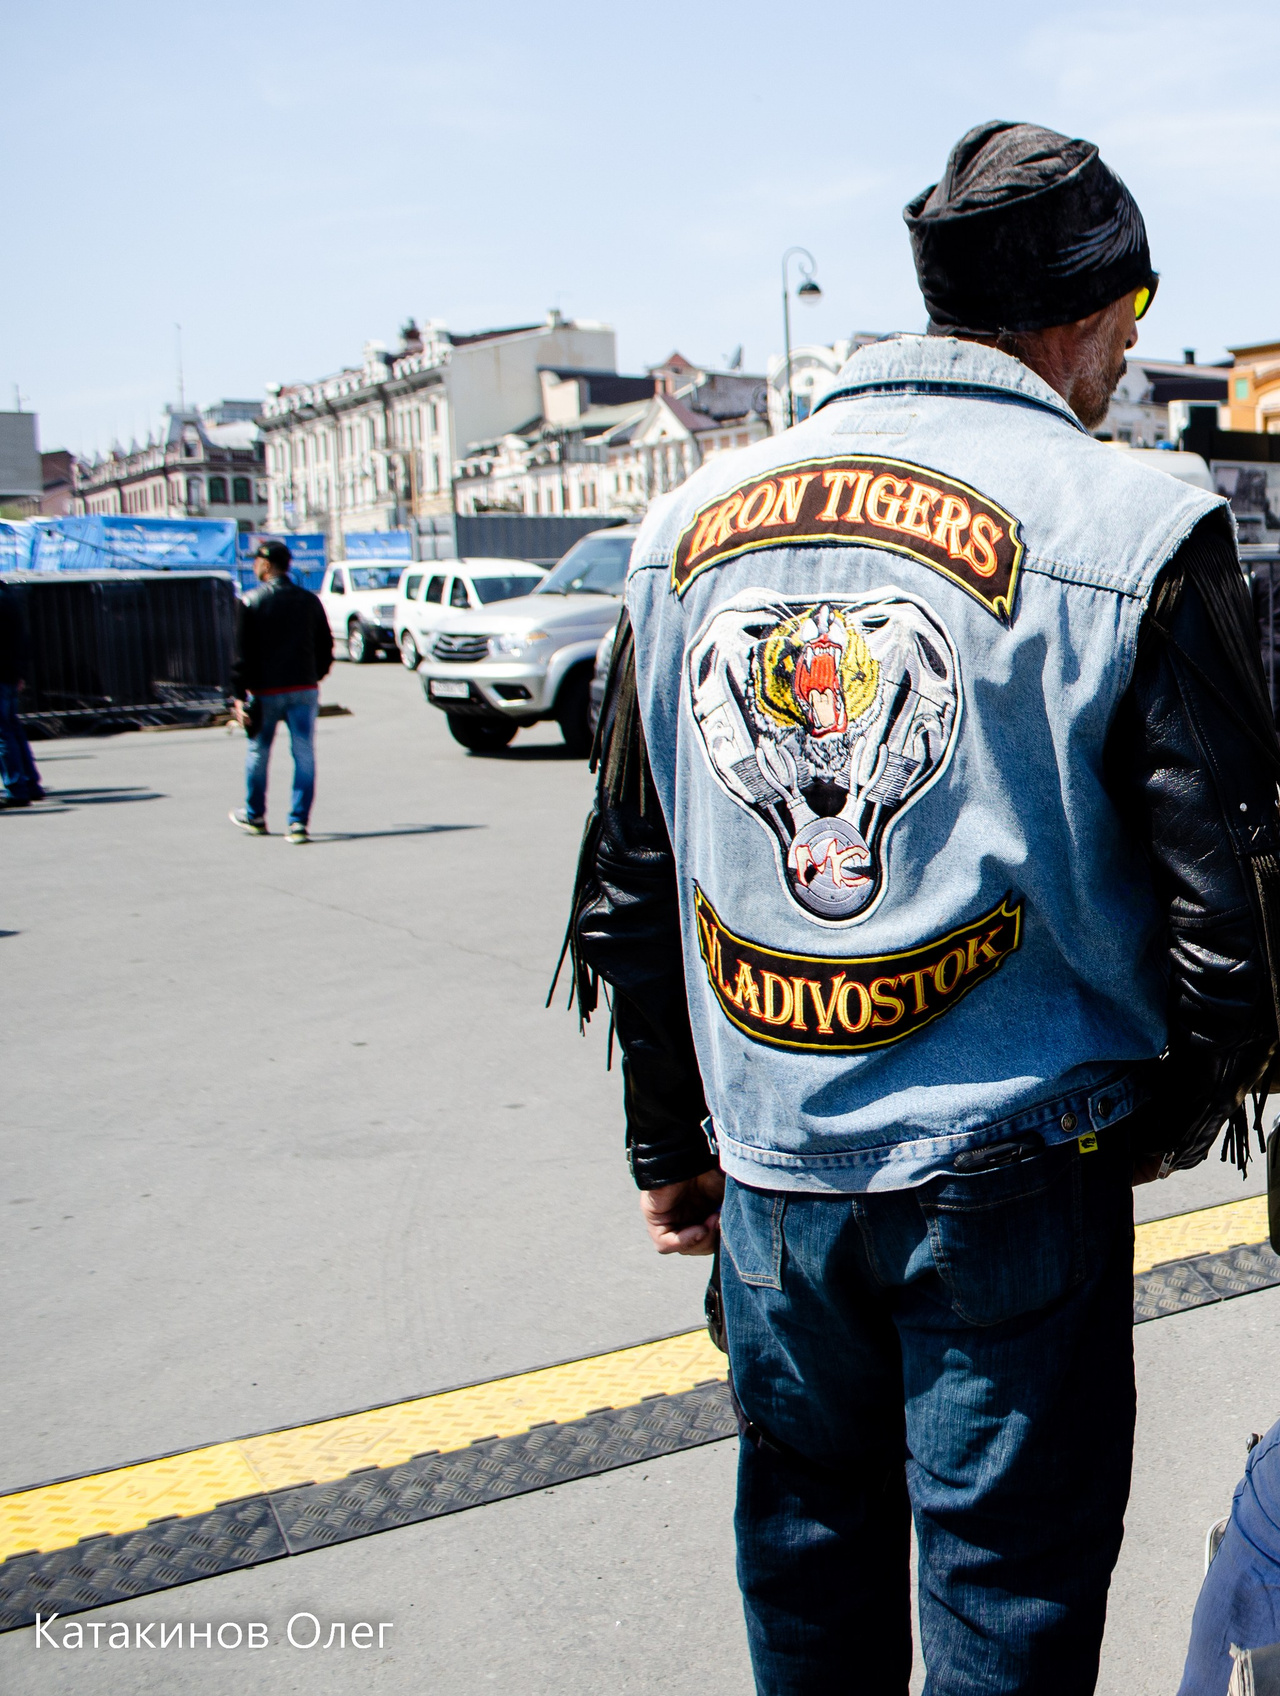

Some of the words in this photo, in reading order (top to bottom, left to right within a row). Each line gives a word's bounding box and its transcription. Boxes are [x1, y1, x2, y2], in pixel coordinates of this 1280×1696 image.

[684, 471, 821, 567] IRON
[816, 469, 1005, 578] TIGERS
[794, 837, 871, 890] MC
[701, 916, 1007, 1034] VLADIVOSTOK
